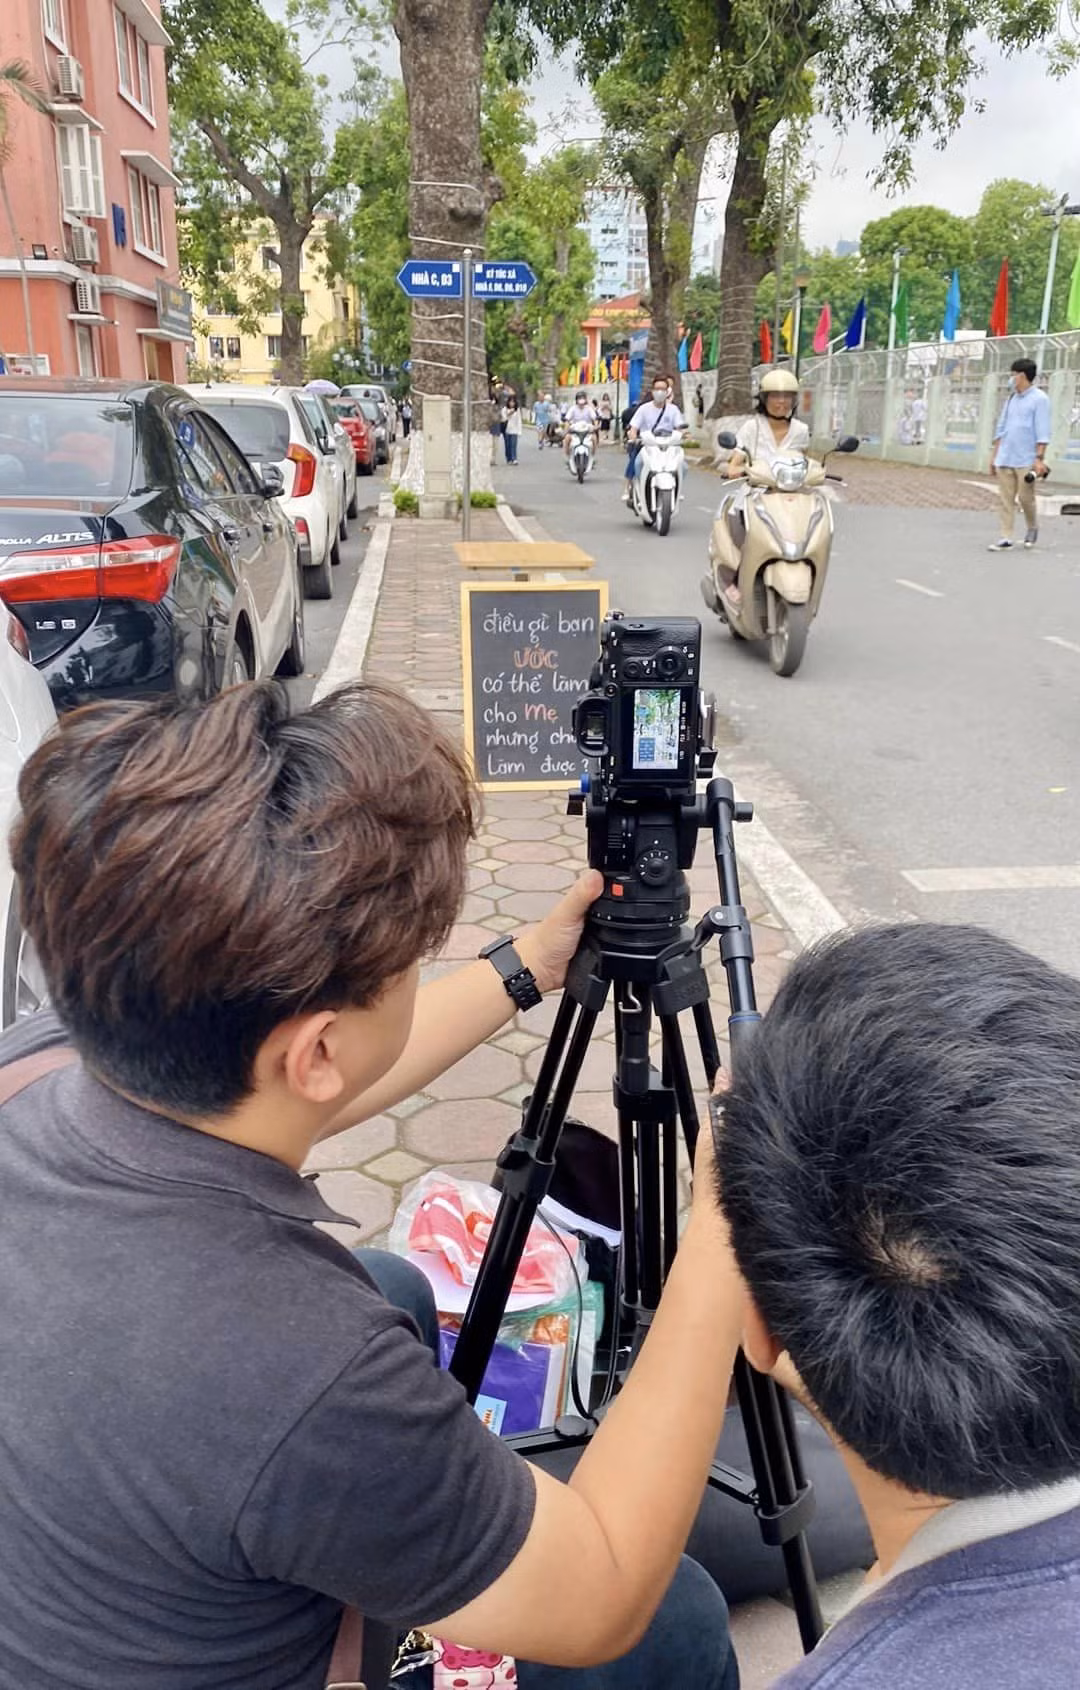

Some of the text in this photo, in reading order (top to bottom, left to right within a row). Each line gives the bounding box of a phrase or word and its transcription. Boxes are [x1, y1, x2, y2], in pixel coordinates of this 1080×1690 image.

[411, 270, 430, 286] NHÀ
[431, 272, 440, 287] C,
[35, 531, 95, 545] ALTIS
[483, 607, 595, 644] điều gì bạn
[482, 671, 506, 693] có
[507, 672, 543, 694] thể
[483, 702, 518, 723] cho
[540, 754, 577, 776] được
